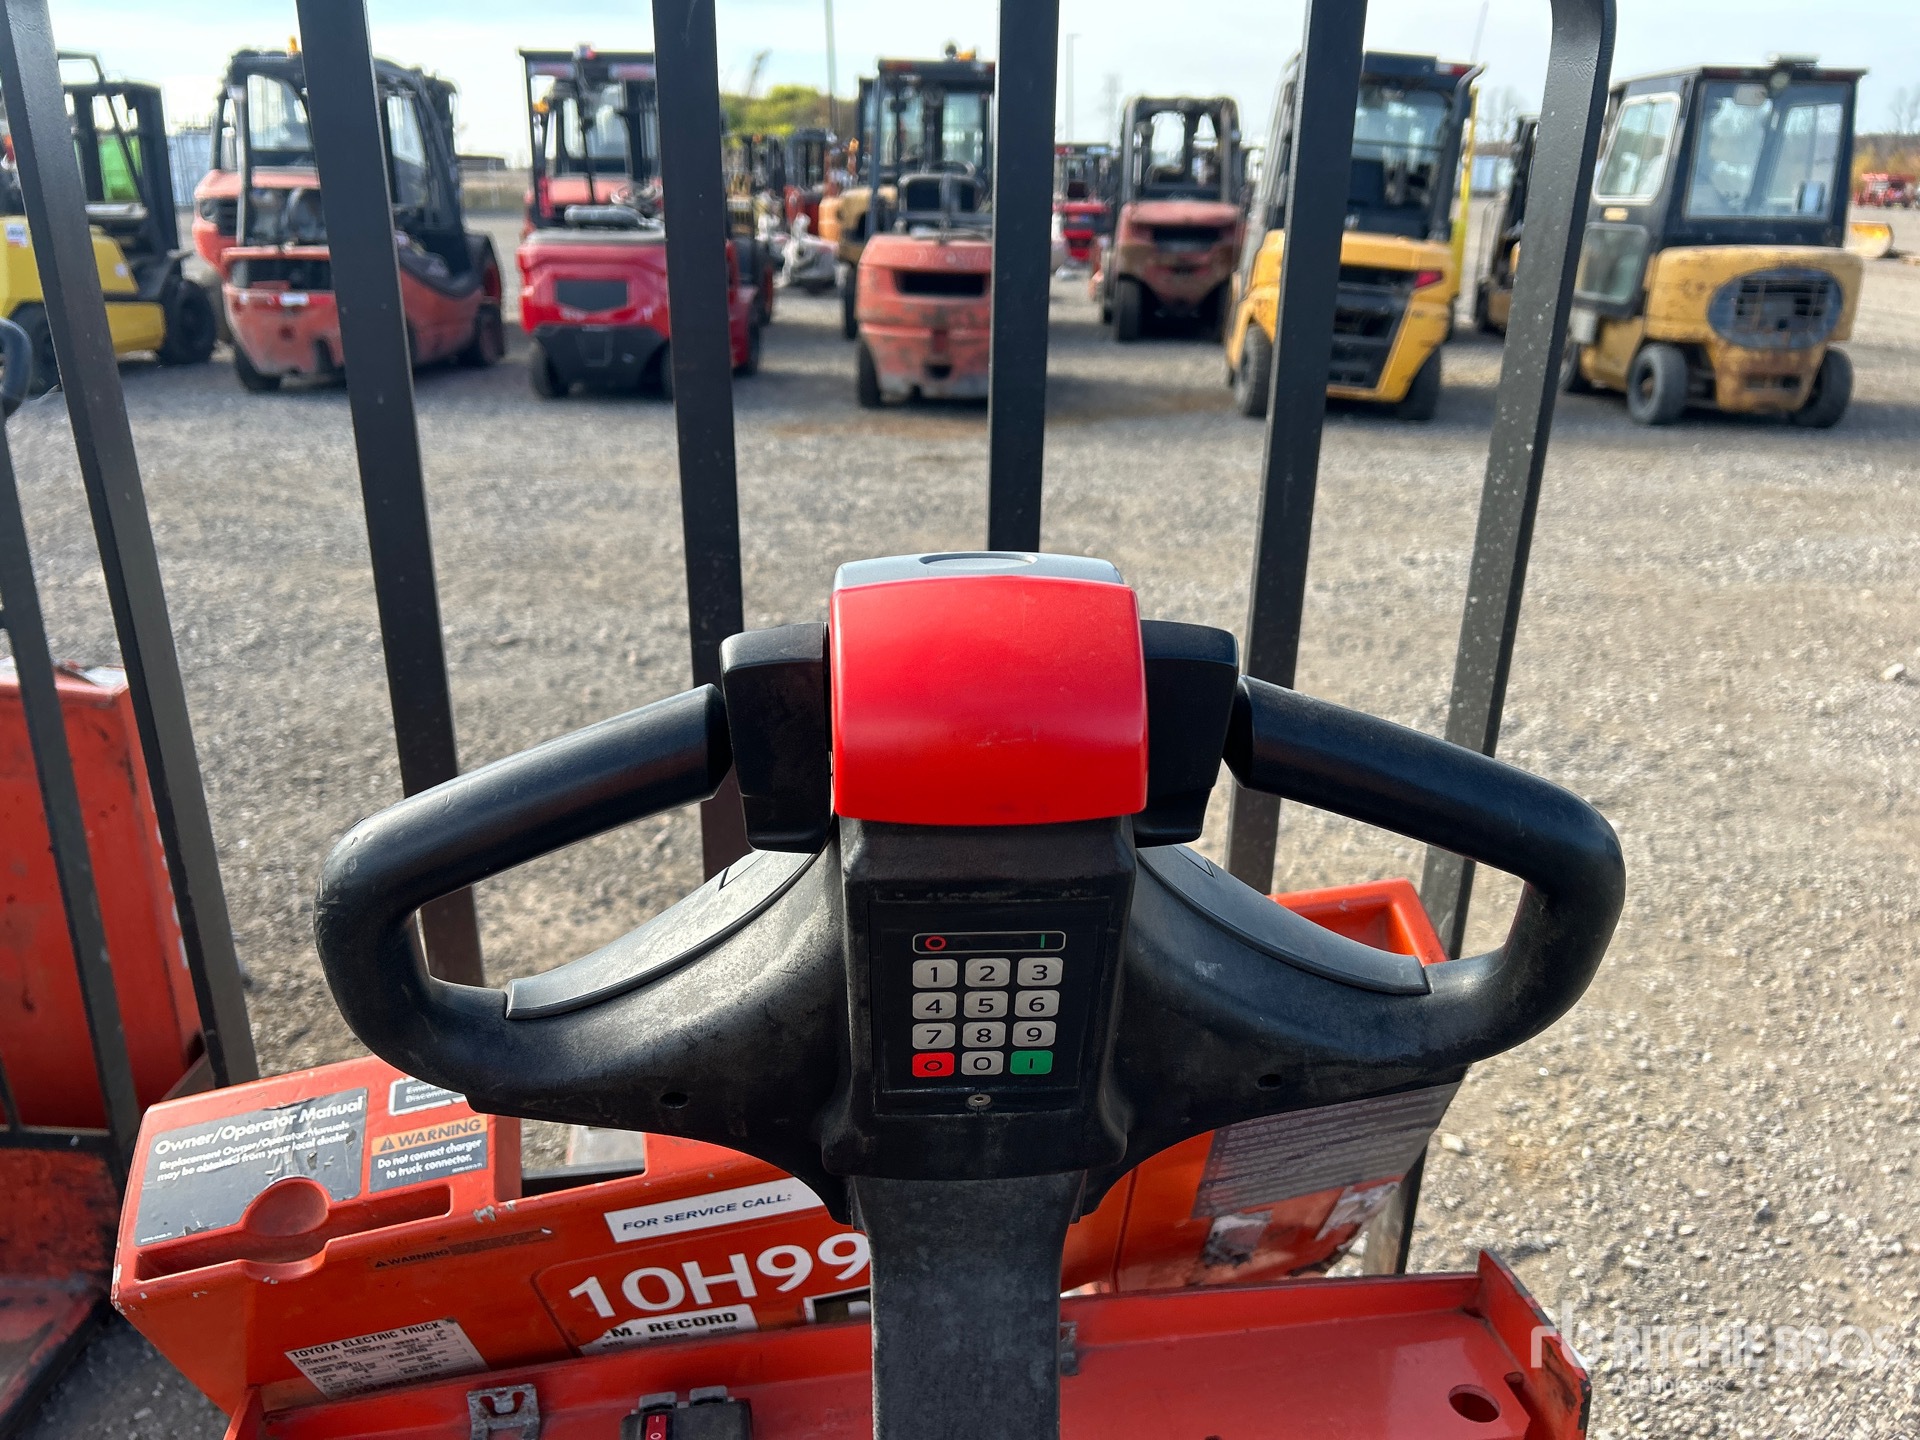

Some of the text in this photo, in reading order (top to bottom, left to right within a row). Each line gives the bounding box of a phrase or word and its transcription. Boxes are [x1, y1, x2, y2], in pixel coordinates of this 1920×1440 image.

[930, 964, 1048, 982] 1 2 3
[925, 996, 1045, 1014] 4 5 6
[926, 1027, 1043, 1044] 7 8 9
[973, 1057, 992, 1071] 0
[155, 1096, 363, 1155] Owner/Operator Manual
[398, 1119, 481, 1147] WARNING
[157, 1132, 349, 1182] may be obtained from your local dealer
[159, 1120, 350, 1170] Replacement Owner/Operator Manuals
[378, 1139, 483, 1169] Do not connect charger
[386, 1170, 397, 1179] to
[398, 1163, 423, 1177] truck
[424, 1153, 473, 1171] connector.
[623, 1194, 792, 1231] FOR SERVICE CALL:
[388, 1249, 450, 1266] WARNING
[569, 1232, 870, 1318] 10H99
[648, 1312, 738, 1333] RECORD
[291, 1344, 340, 1358] TOYOTA
[341, 1331, 399, 1348] ELECTRIC
[400, 1322, 442, 1335] TRUCK
